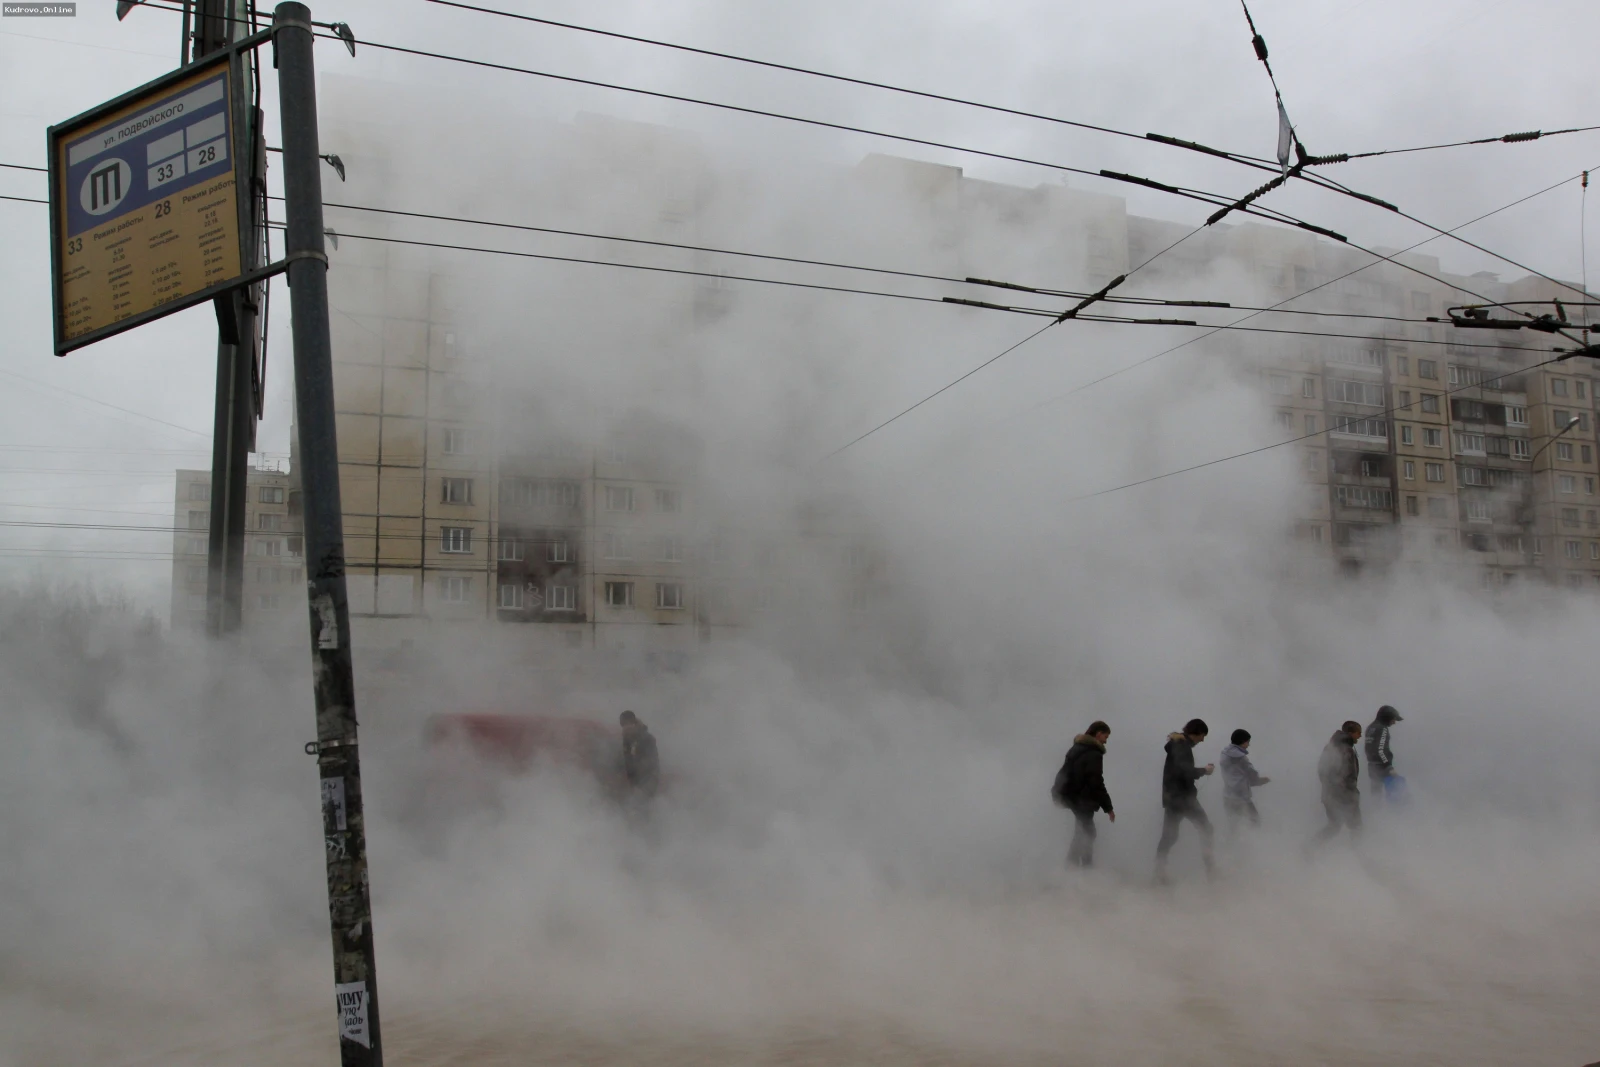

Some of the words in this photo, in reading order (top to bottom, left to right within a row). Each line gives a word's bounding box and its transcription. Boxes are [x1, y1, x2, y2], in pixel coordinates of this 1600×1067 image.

[104, 137, 115, 148] ул.
[118, 103, 184, 139] ПОДВОЙСКОГО
[199, 146, 215, 165] 28
[157, 164, 173, 182] 33
[182, 190, 207, 204] Режим
[155, 200, 171, 219] 28
[94, 228, 116, 241] Режим
[117, 216, 143, 232] работы
[68, 238, 82, 256] 33
